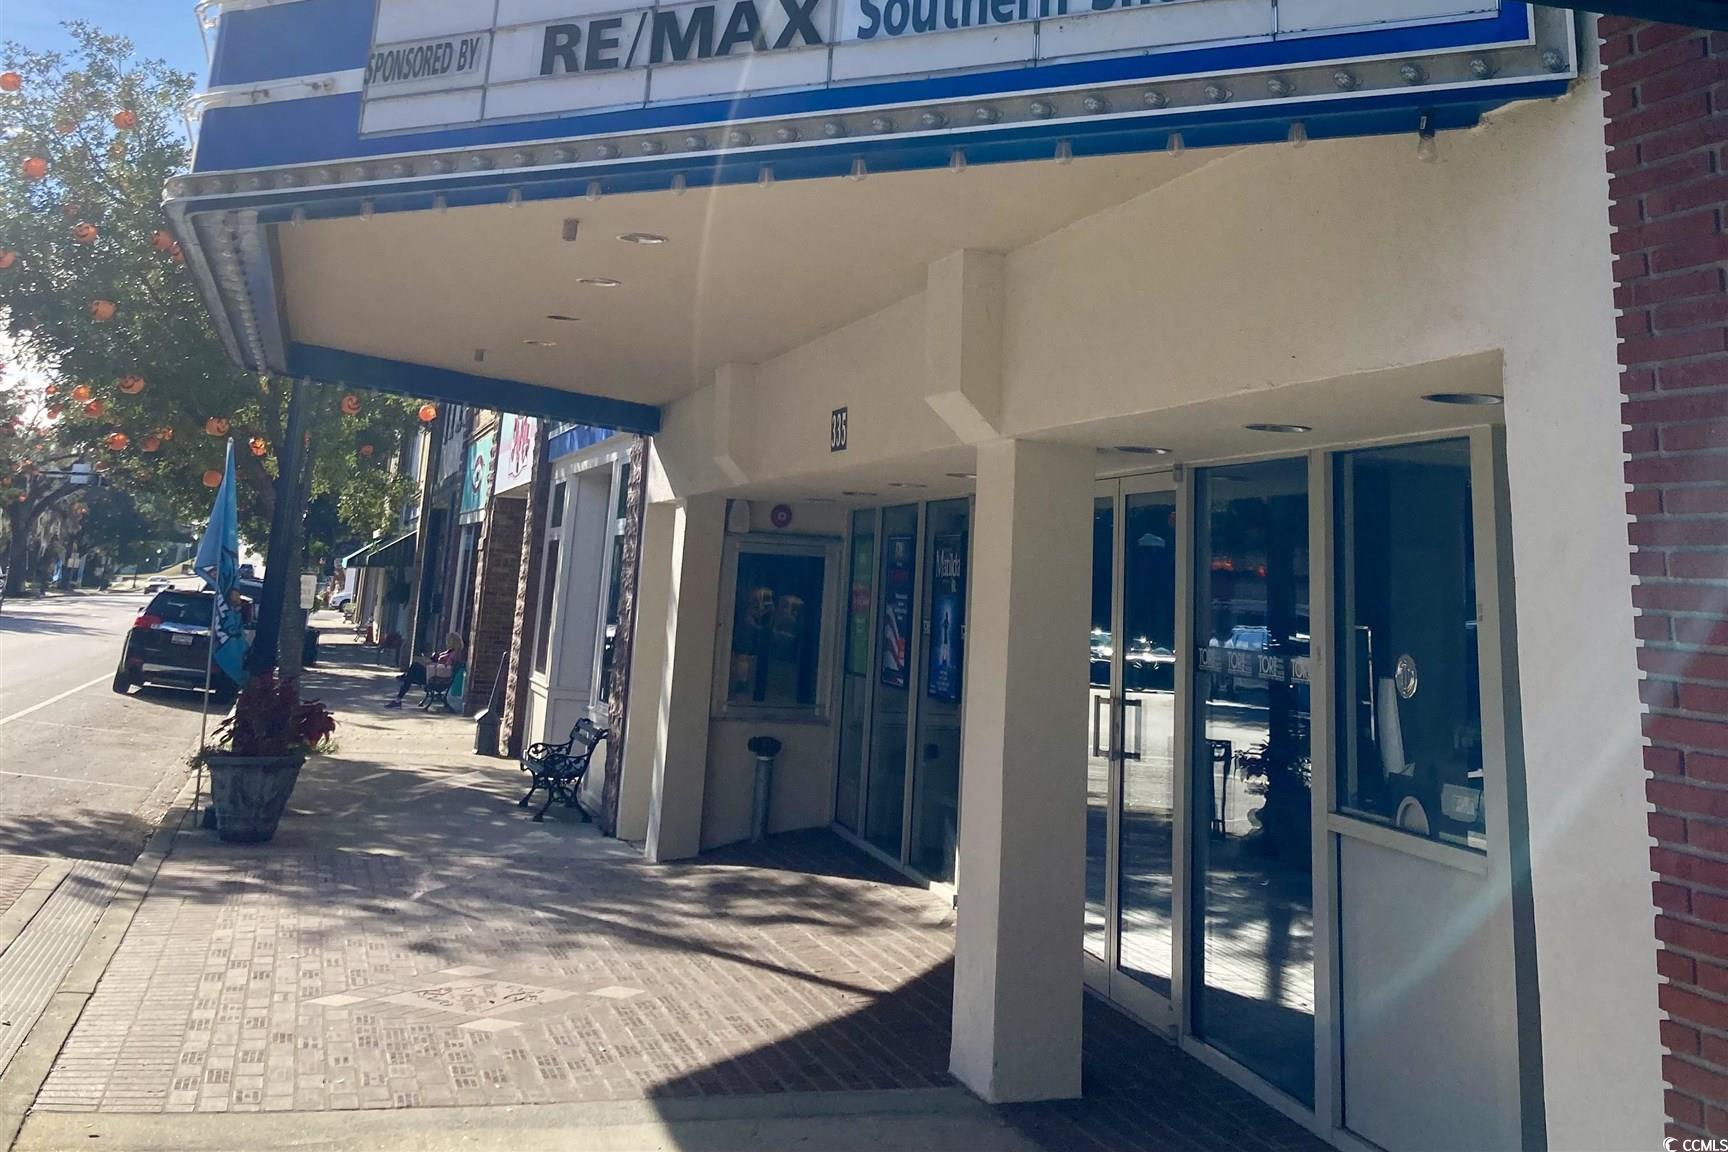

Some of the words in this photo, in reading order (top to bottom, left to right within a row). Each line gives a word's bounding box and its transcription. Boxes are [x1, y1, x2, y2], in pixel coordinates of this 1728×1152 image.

[364, 41, 454, 85] SPONSORED
[456, 36, 481, 71] BY
[831, 411, 847, 448] 335
